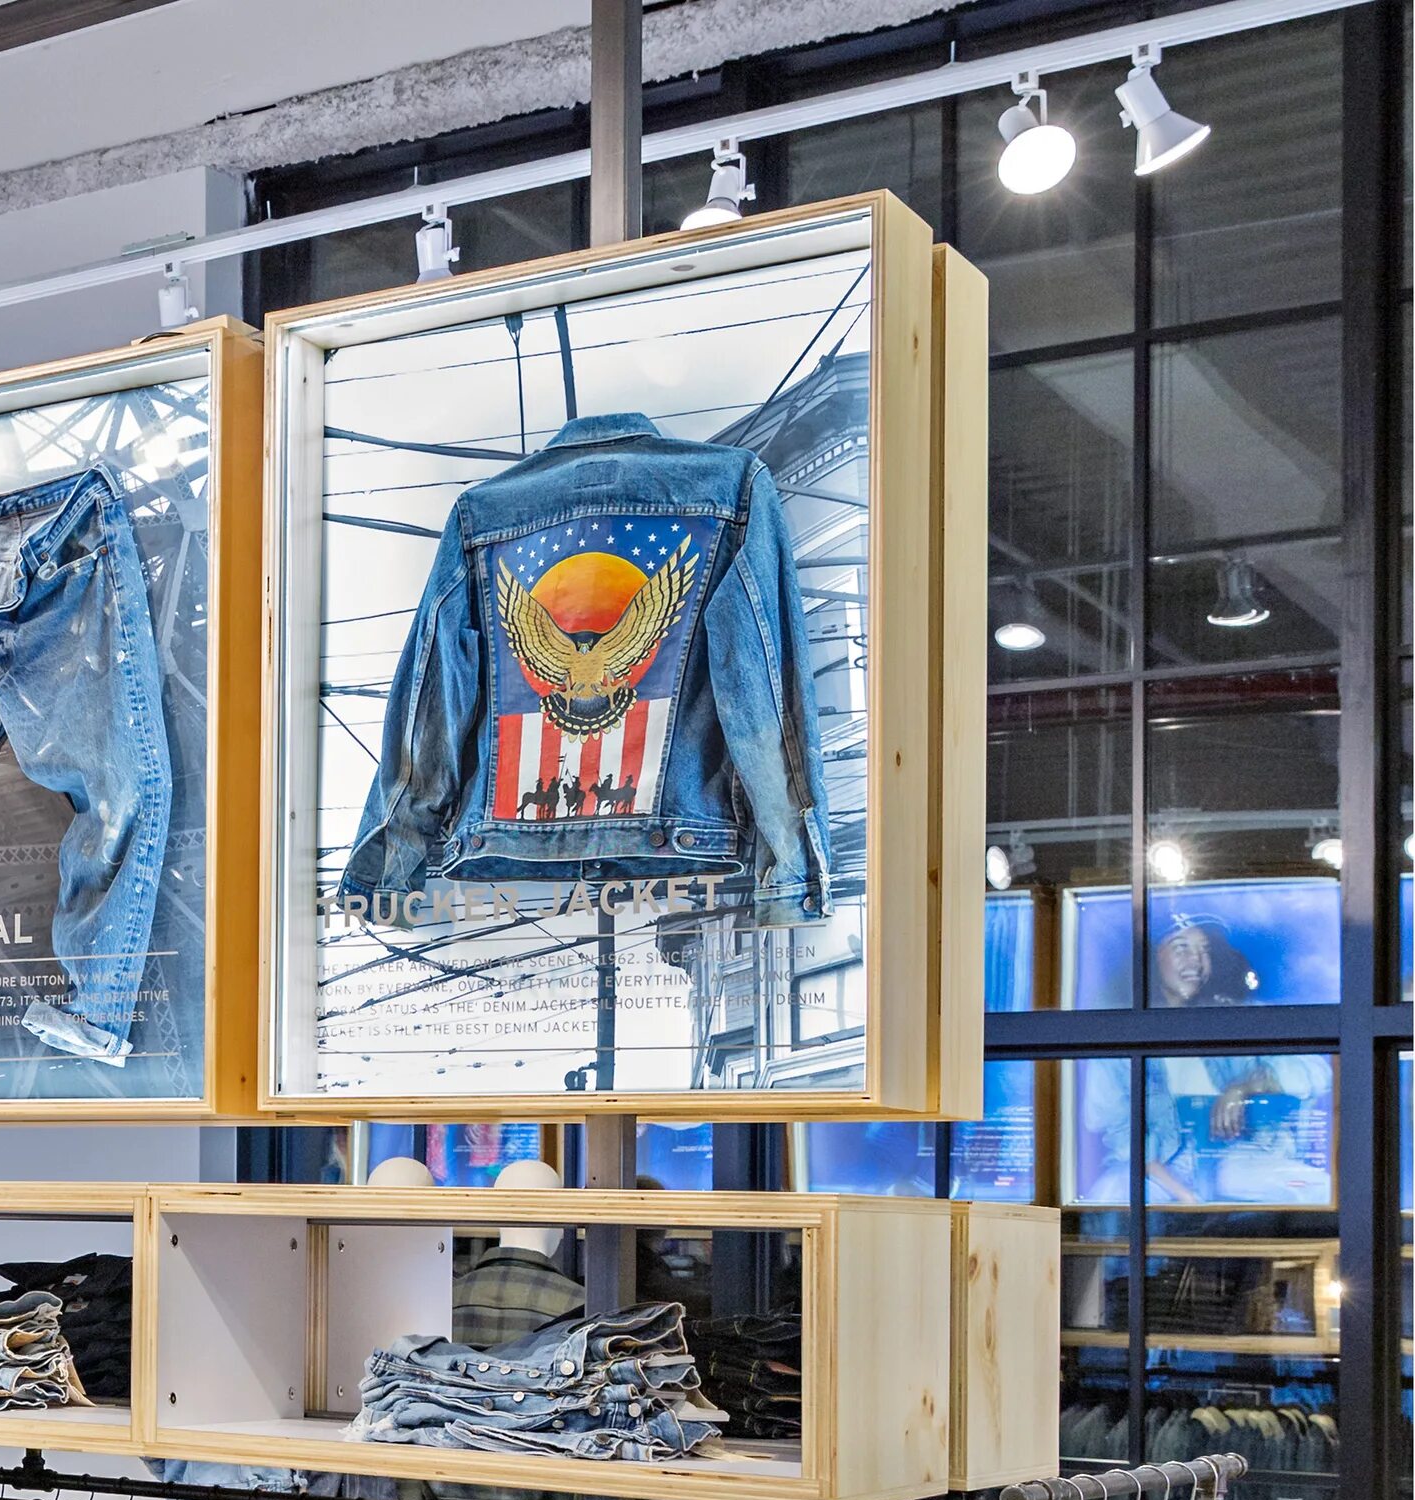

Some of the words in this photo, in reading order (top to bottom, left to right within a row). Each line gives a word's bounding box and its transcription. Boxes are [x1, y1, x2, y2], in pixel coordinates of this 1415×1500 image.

[318, 888, 518, 929] TRUCKER
[536, 877, 725, 918] JACKET
[530, 954, 575, 968] SCENE
[600, 953, 640, 965] 1962.
[646, 951, 689, 964] SINCE
[775, 946, 815, 958] BEEN
[20, 975, 65, 987] BUTTON
[357, 984, 373, 995] BY
[458, 980, 493, 992] OVER
[499, 978, 552, 990] PRETTY
[559, 976, 599, 988] MUCH
[20, 995, 39, 1006] IT'S
[43, 994, 73, 1005] STILL
[104, 990, 169, 1003] DEFINITIVE
[370, 1003, 417, 1015] STATUS
[423, 1003, 439, 1013] AS
[483, 1001, 526, 1012] DENIM
[532, 999, 586, 1011] JACKET
[591, 997, 687, 1011] SILHOUETTE,
[776, 992, 825, 1005] DENIM
[369, 1025, 380, 1036] IS
[425, 1024, 450, 1035] THE
[456, 1023, 489, 1035] BEST
[495, 1022, 537, 1034] DENIM
